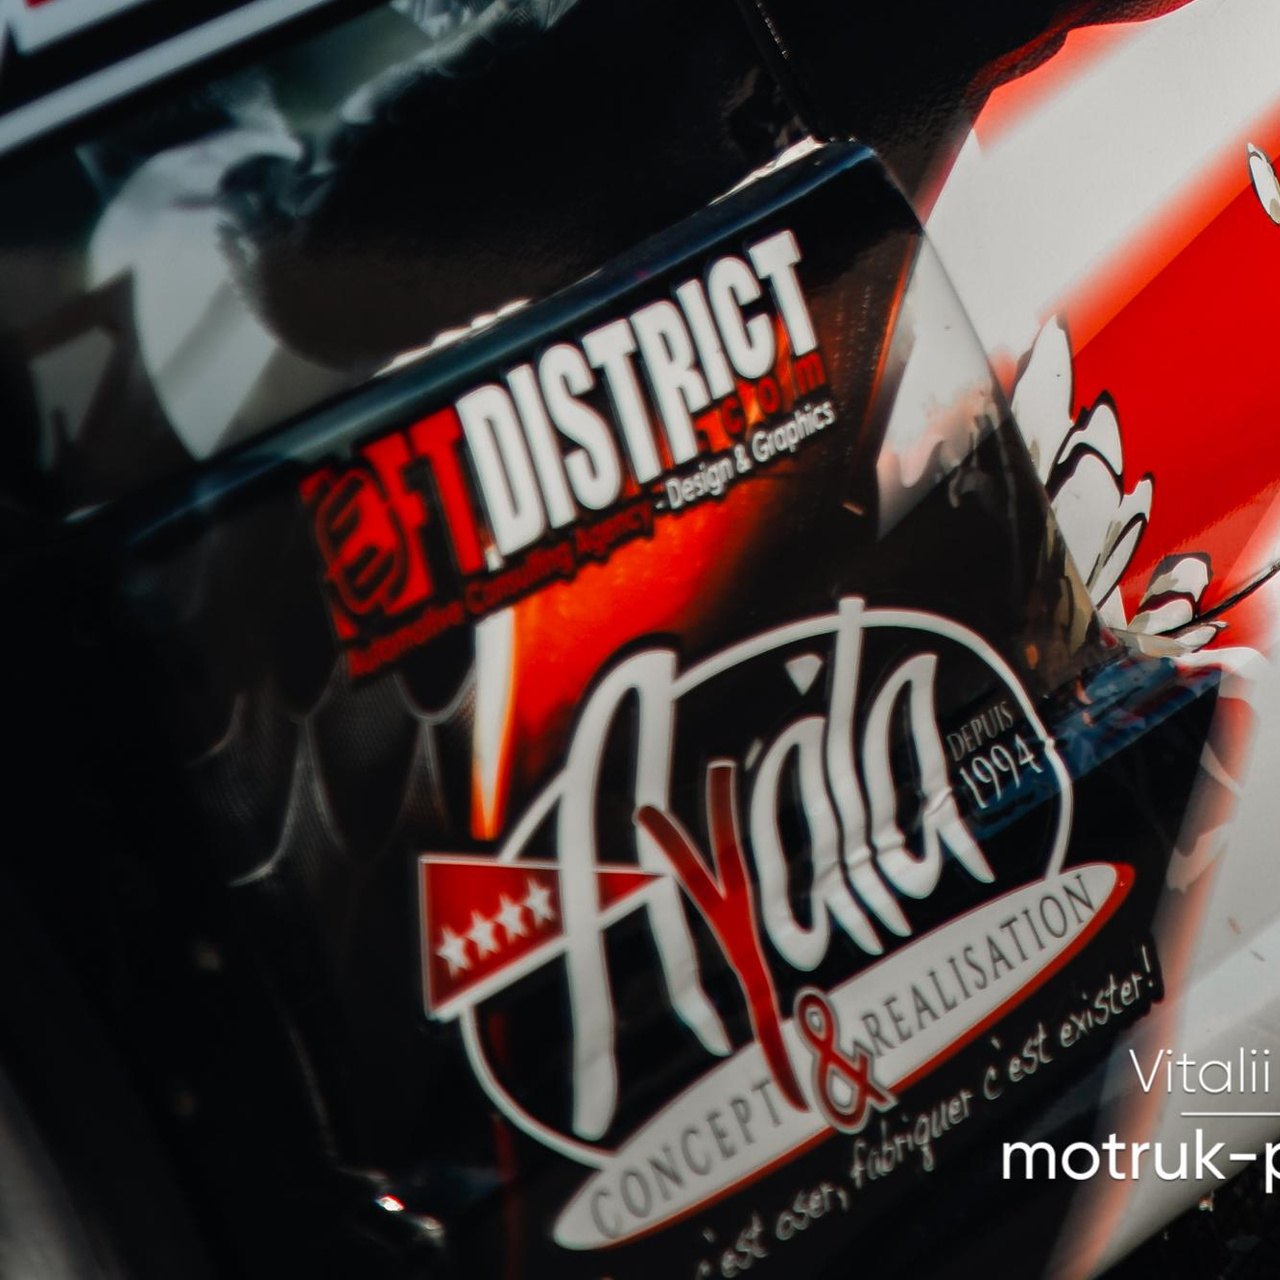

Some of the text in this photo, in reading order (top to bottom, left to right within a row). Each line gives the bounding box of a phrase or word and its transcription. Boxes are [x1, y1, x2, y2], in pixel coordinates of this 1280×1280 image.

[455, 229, 818, 557] DISTRICT
[665, 456, 735, 509] Design
[734, 444, 752, 474] &
[752, 401, 837, 462] Graphics
[948, 701, 1013, 761] DEPUIS
[959, 734, 1043, 809] 1994
[588, 874, 1097, 1239] CONCEPT & REALISATION
[983, 1019, 1053, 1102] c'est
